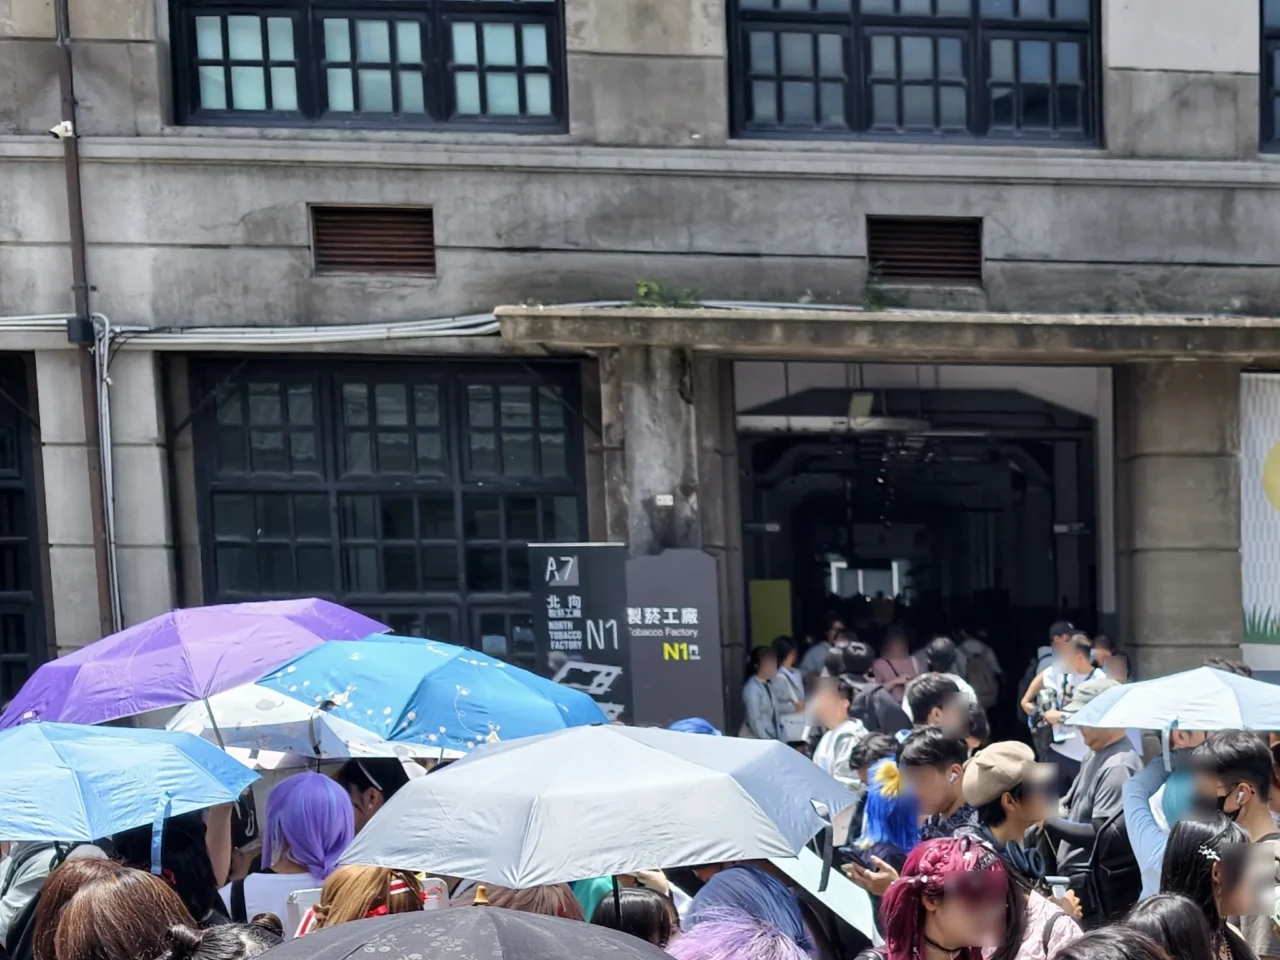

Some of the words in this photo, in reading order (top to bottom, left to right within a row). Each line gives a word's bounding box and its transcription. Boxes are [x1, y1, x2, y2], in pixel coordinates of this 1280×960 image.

[545, 556, 573, 582] A7
[547, 595, 582, 609] 北向
[626, 607, 699, 625] 製菸工廠
[548, 621, 574, 630] NORTH
[549, 631, 583, 640] TOBACCO
[586, 619, 619, 650] N1
[551, 641, 583, 650] FACTORY
